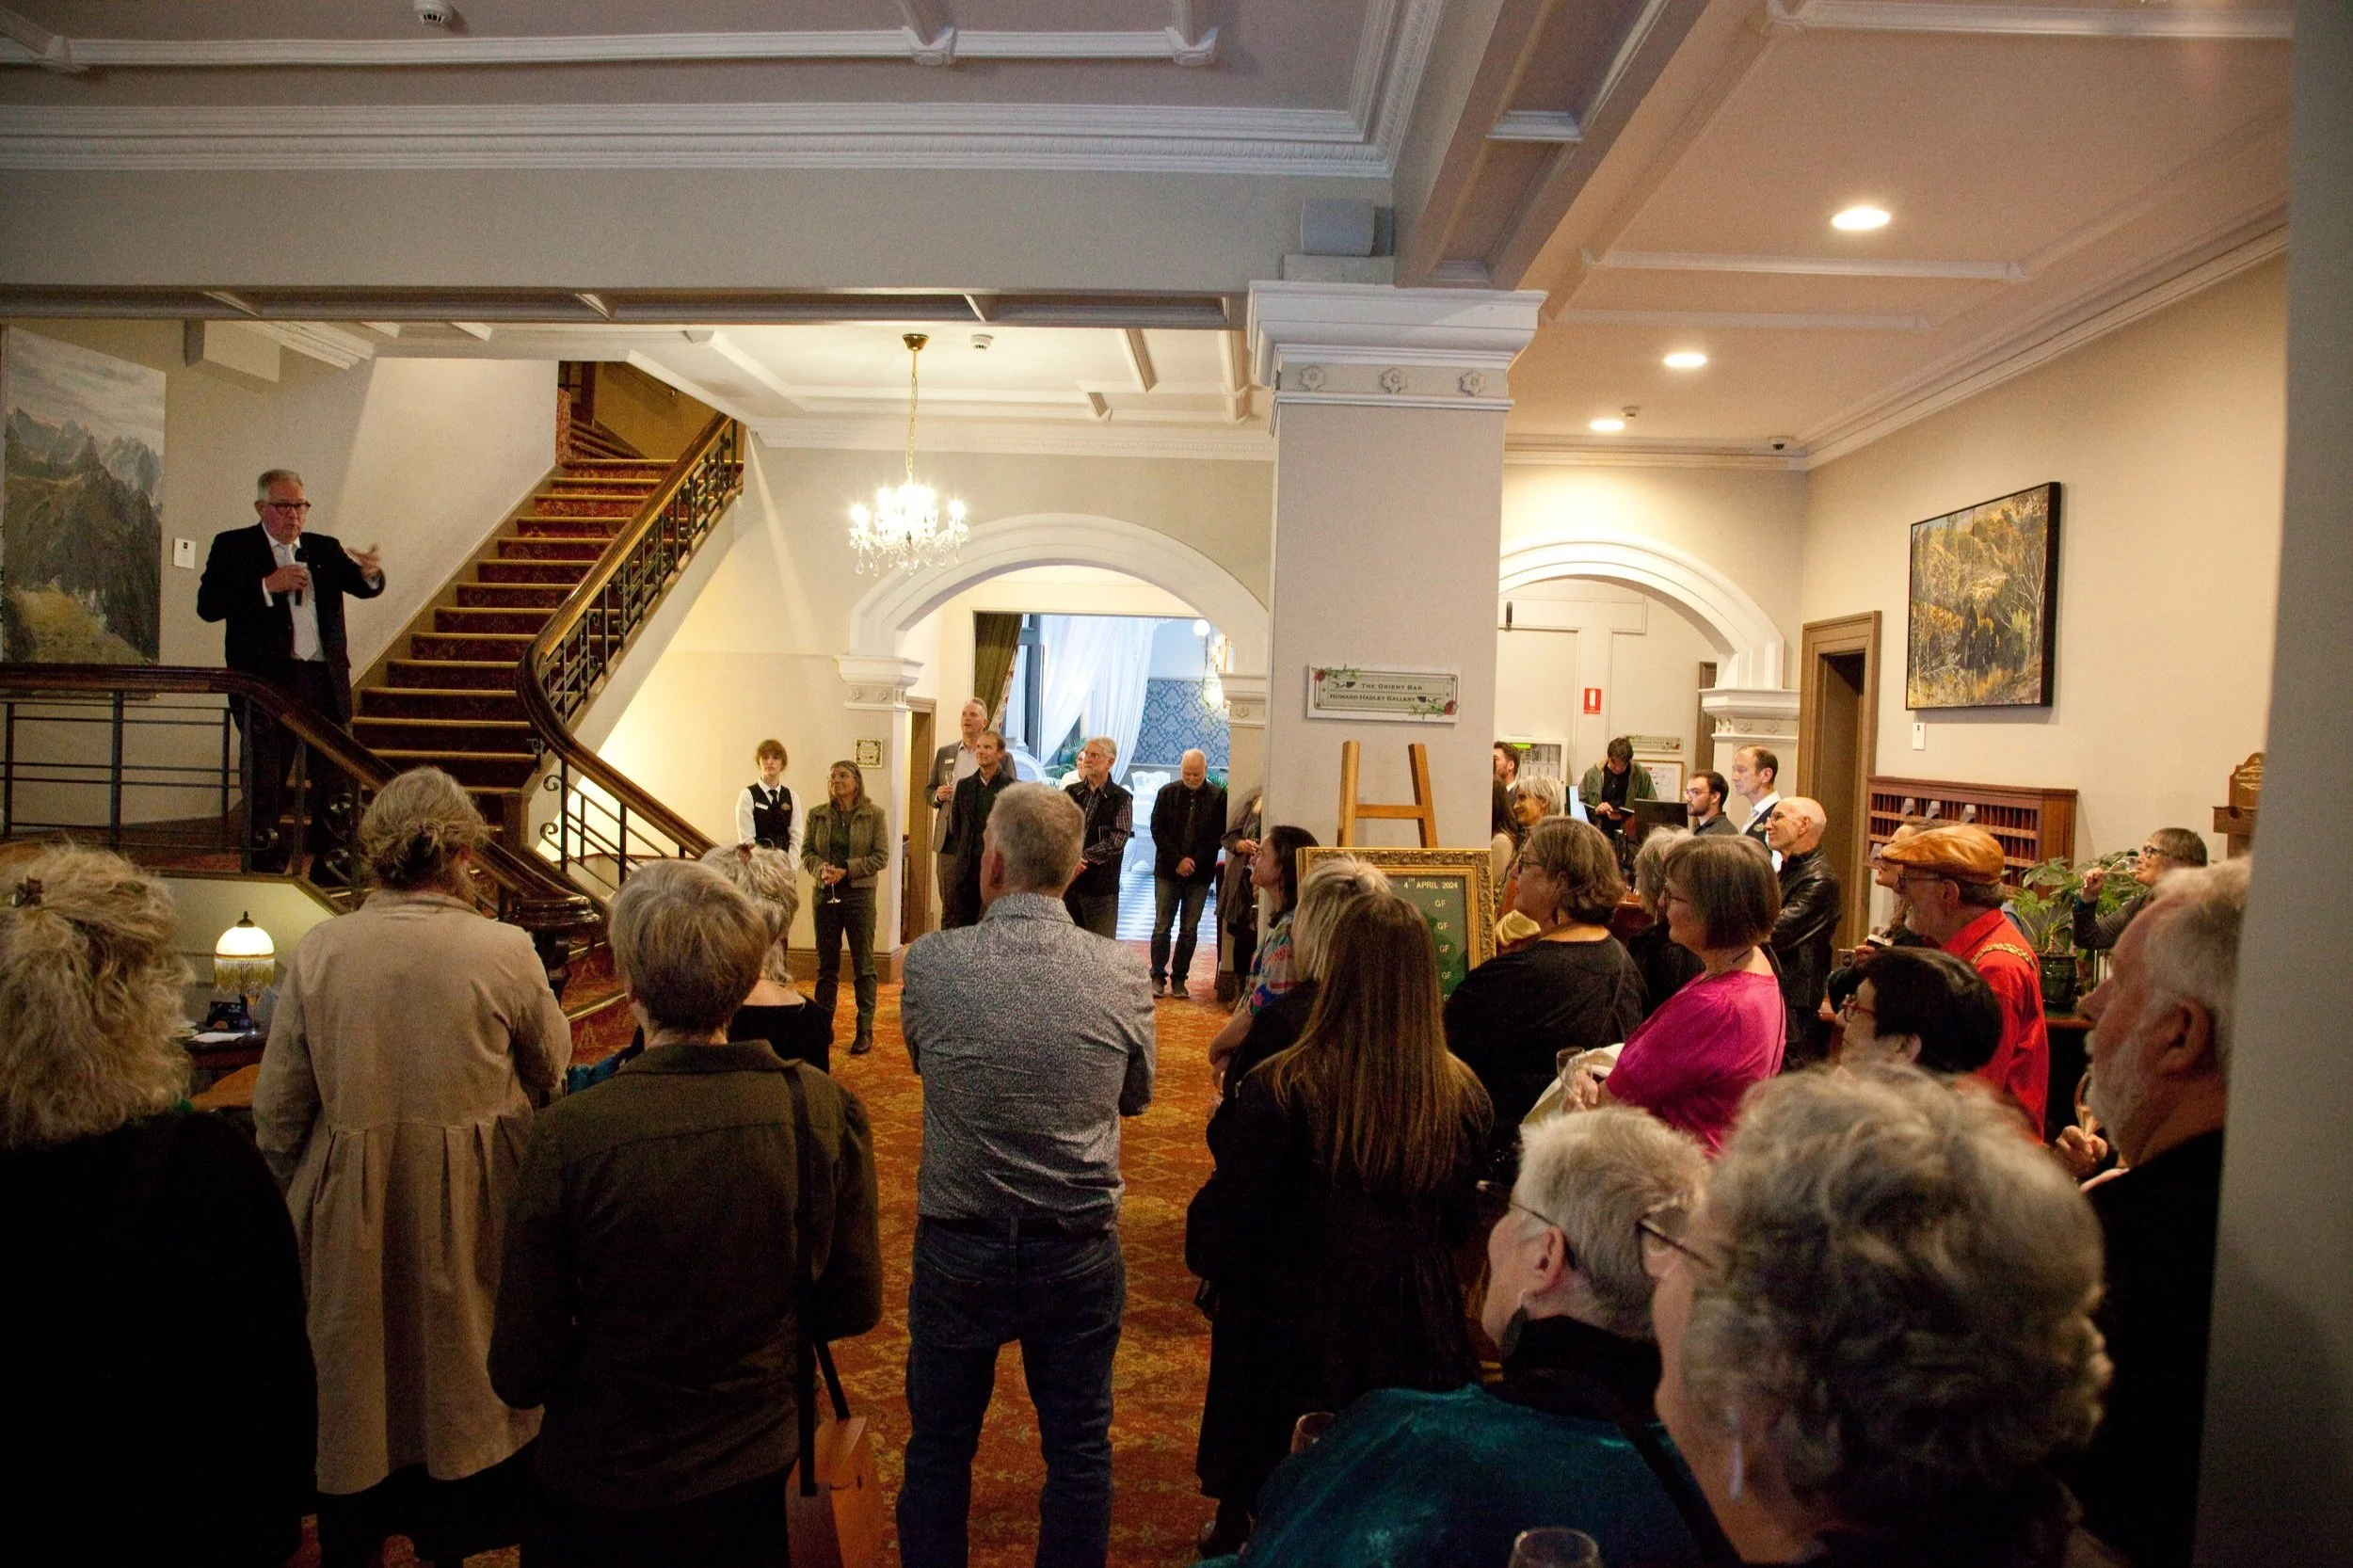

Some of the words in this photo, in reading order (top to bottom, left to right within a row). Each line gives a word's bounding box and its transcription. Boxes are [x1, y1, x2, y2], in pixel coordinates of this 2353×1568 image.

[1417, 881, 1439, 889] APRIL
[1442, 881, 1458, 889] 2024
[1434, 899, 1446, 908] GF
[1437, 921, 1449, 930] GF
[1439, 944, 1450, 953] GF
[1441, 971, 1452, 980] GF
